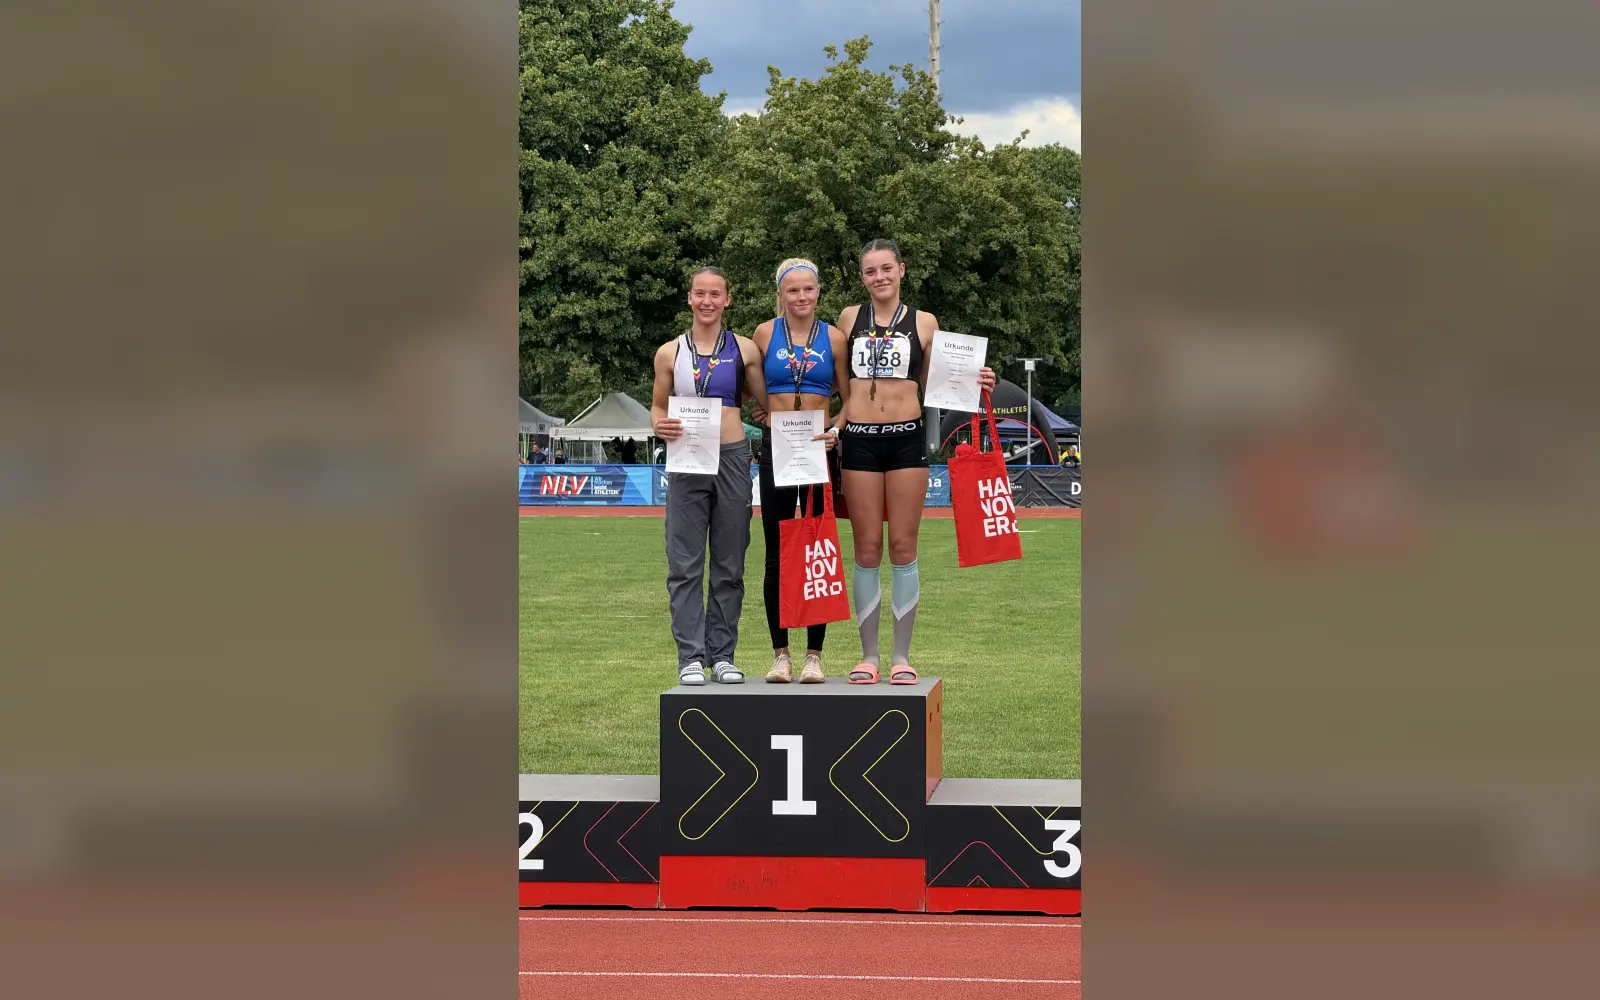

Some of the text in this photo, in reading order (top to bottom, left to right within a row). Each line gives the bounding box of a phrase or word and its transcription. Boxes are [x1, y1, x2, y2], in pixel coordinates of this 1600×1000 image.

[944, 341, 974, 352] Urkunde
[679, 406, 710, 415] Urkunde
[992, 405, 1028, 414] ATHLETES
[782, 419, 812, 427] Urkunde
[845, 422, 917, 434] NIKE PRO
[540, 475, 589, 496] NLV
[983, 516, 1011, 538] ER
[805, 538, 837, 564] HAN
[803, 578, 829, 601] ER
[770, 734, 817, 816] 1
[519, 812, 544, 870] 2
[1042, 819, 1081, 878] 3
